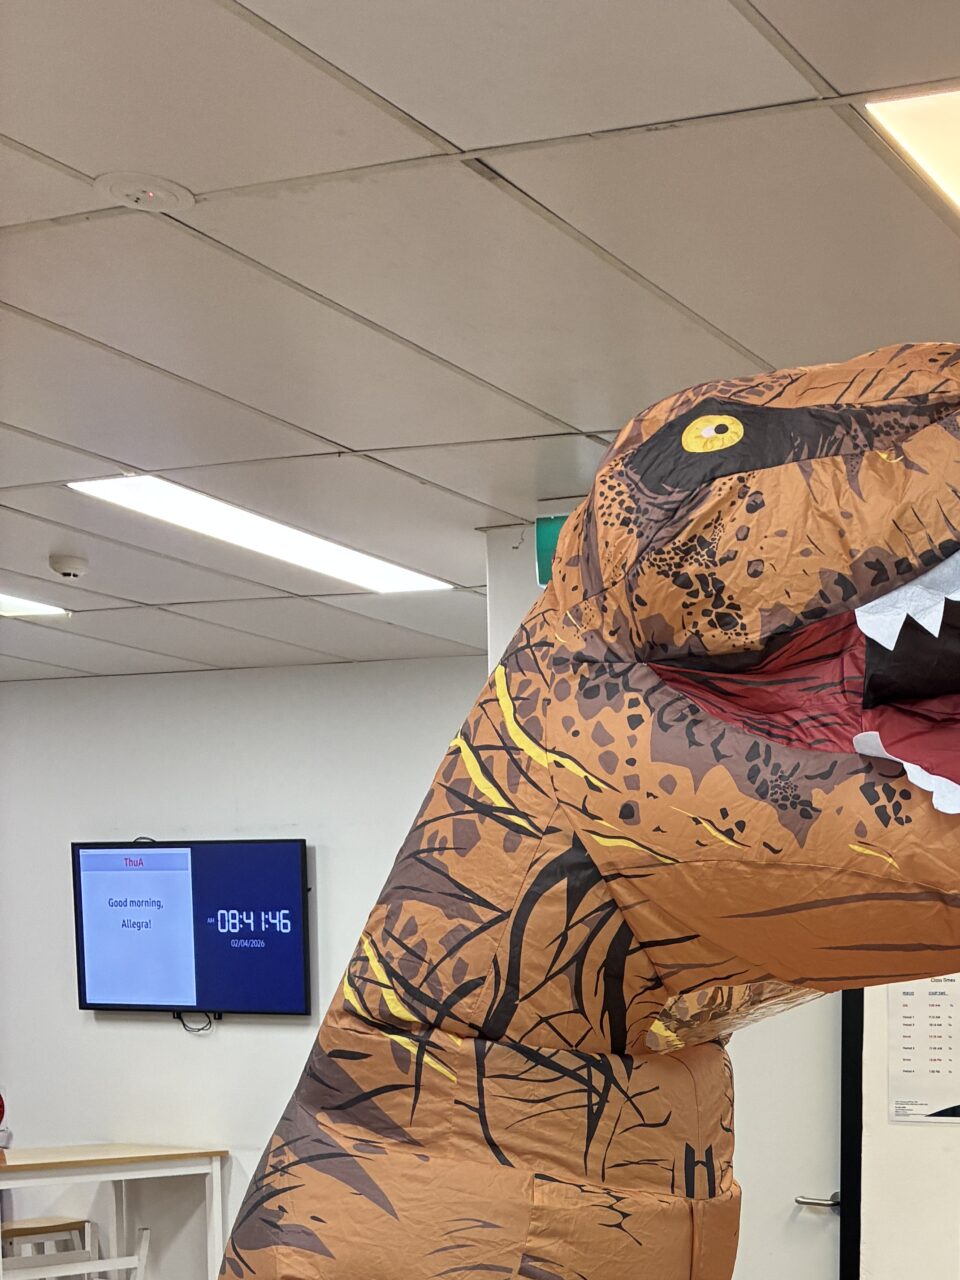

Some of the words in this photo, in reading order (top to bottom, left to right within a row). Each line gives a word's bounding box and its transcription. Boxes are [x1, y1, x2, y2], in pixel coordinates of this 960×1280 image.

[108, 898, 128, 908] Good
[129, 898, 164, 910] morning,
[121, 919, 152, 931] Allegra!
[230, 939, 265, 948] 02/04/2026
